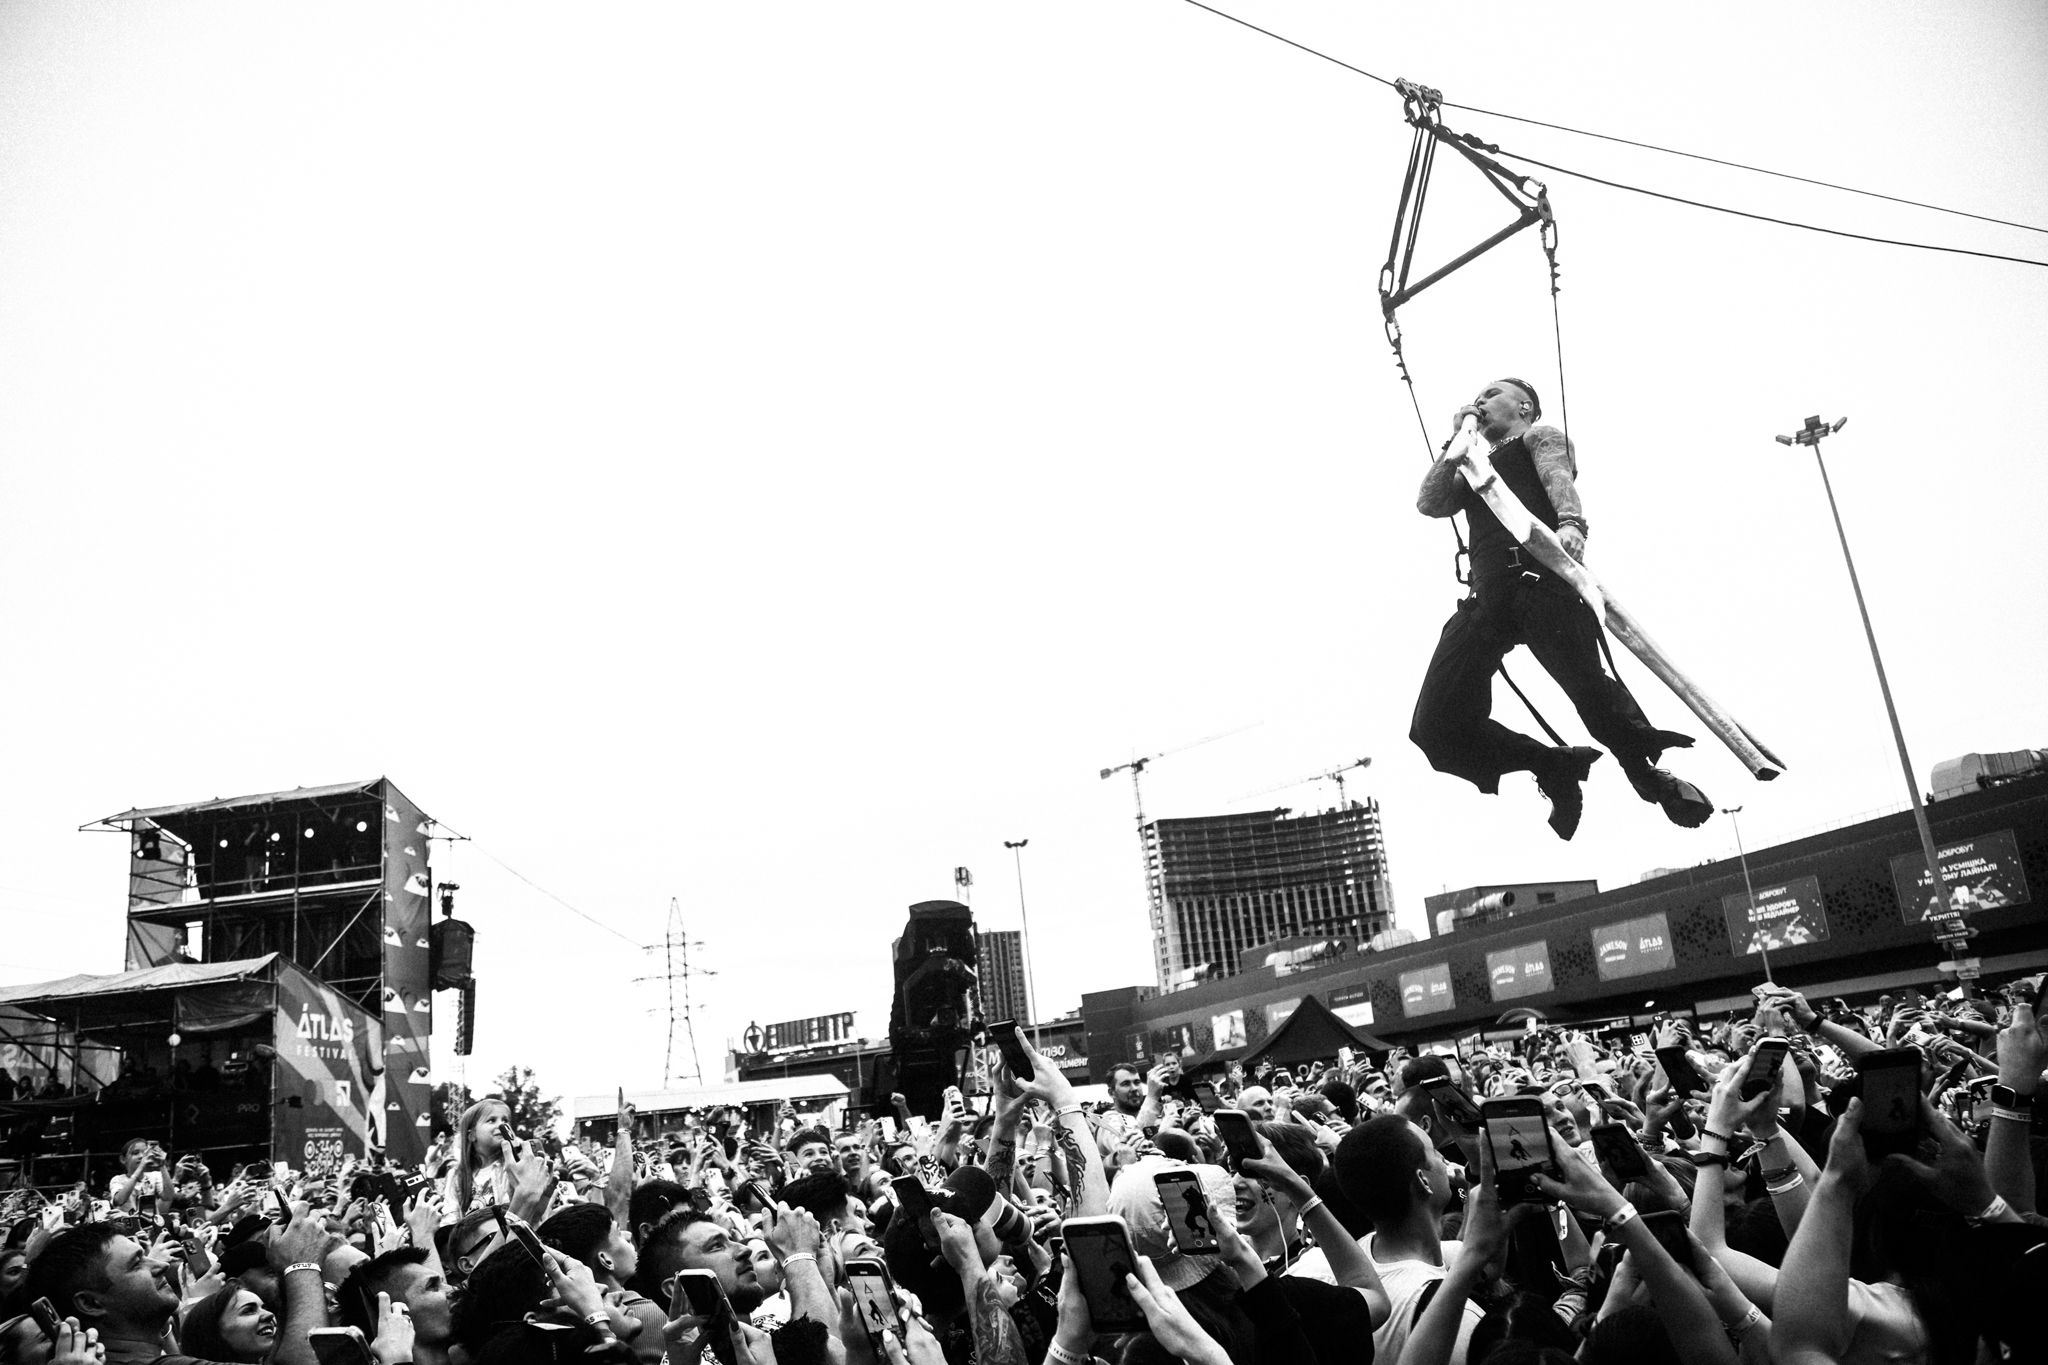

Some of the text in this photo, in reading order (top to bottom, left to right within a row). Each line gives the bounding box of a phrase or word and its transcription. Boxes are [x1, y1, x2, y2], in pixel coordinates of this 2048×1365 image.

[1938, 844, 1975, 859] ДОБРОБУТ
[1917, 863, 1998, 887] У НОМУ ЛАЙНАПІ
[1924, 857, 1987, 878] ВА УСМІШКА
[1759, 887, 1787, 900] ДОБРОБУТ
[297, 1045, 354, 1060] FESTIVAL
